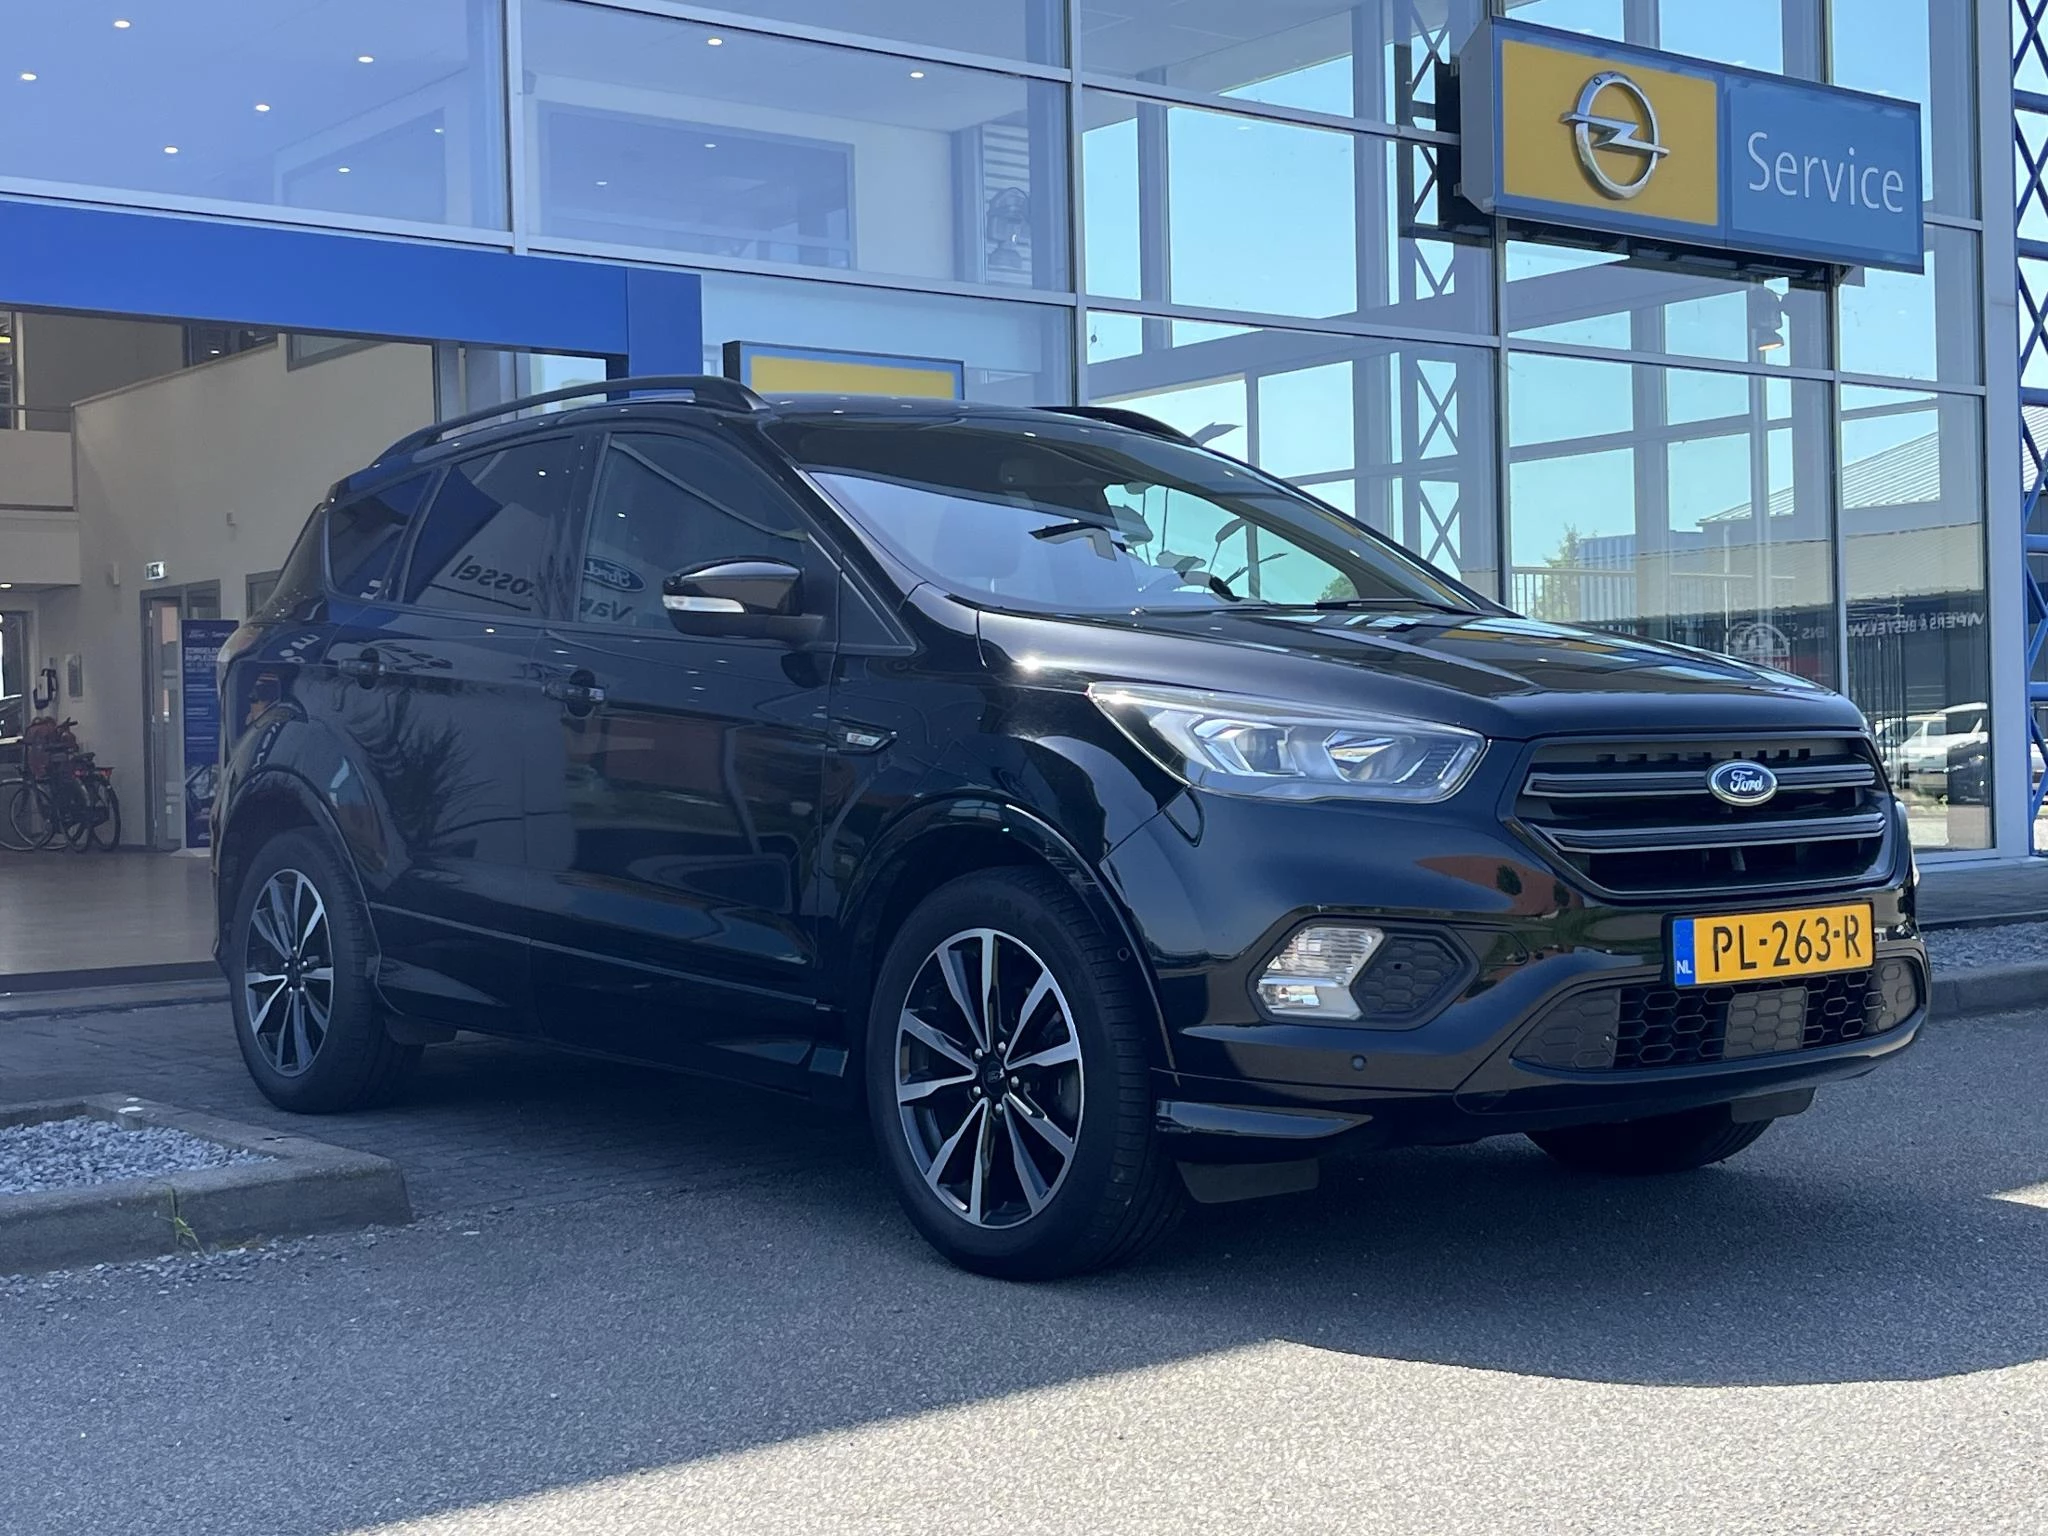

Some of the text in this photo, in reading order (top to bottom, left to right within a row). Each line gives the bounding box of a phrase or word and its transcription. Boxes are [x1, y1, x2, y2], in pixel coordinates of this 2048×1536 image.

[1747, 131, 1904, 213] Service
[1729, 769, 1765, 792] Ford
[1712, 914, 1862, 973] PL-263-R
[1676, 960, 1693, 975] NL
